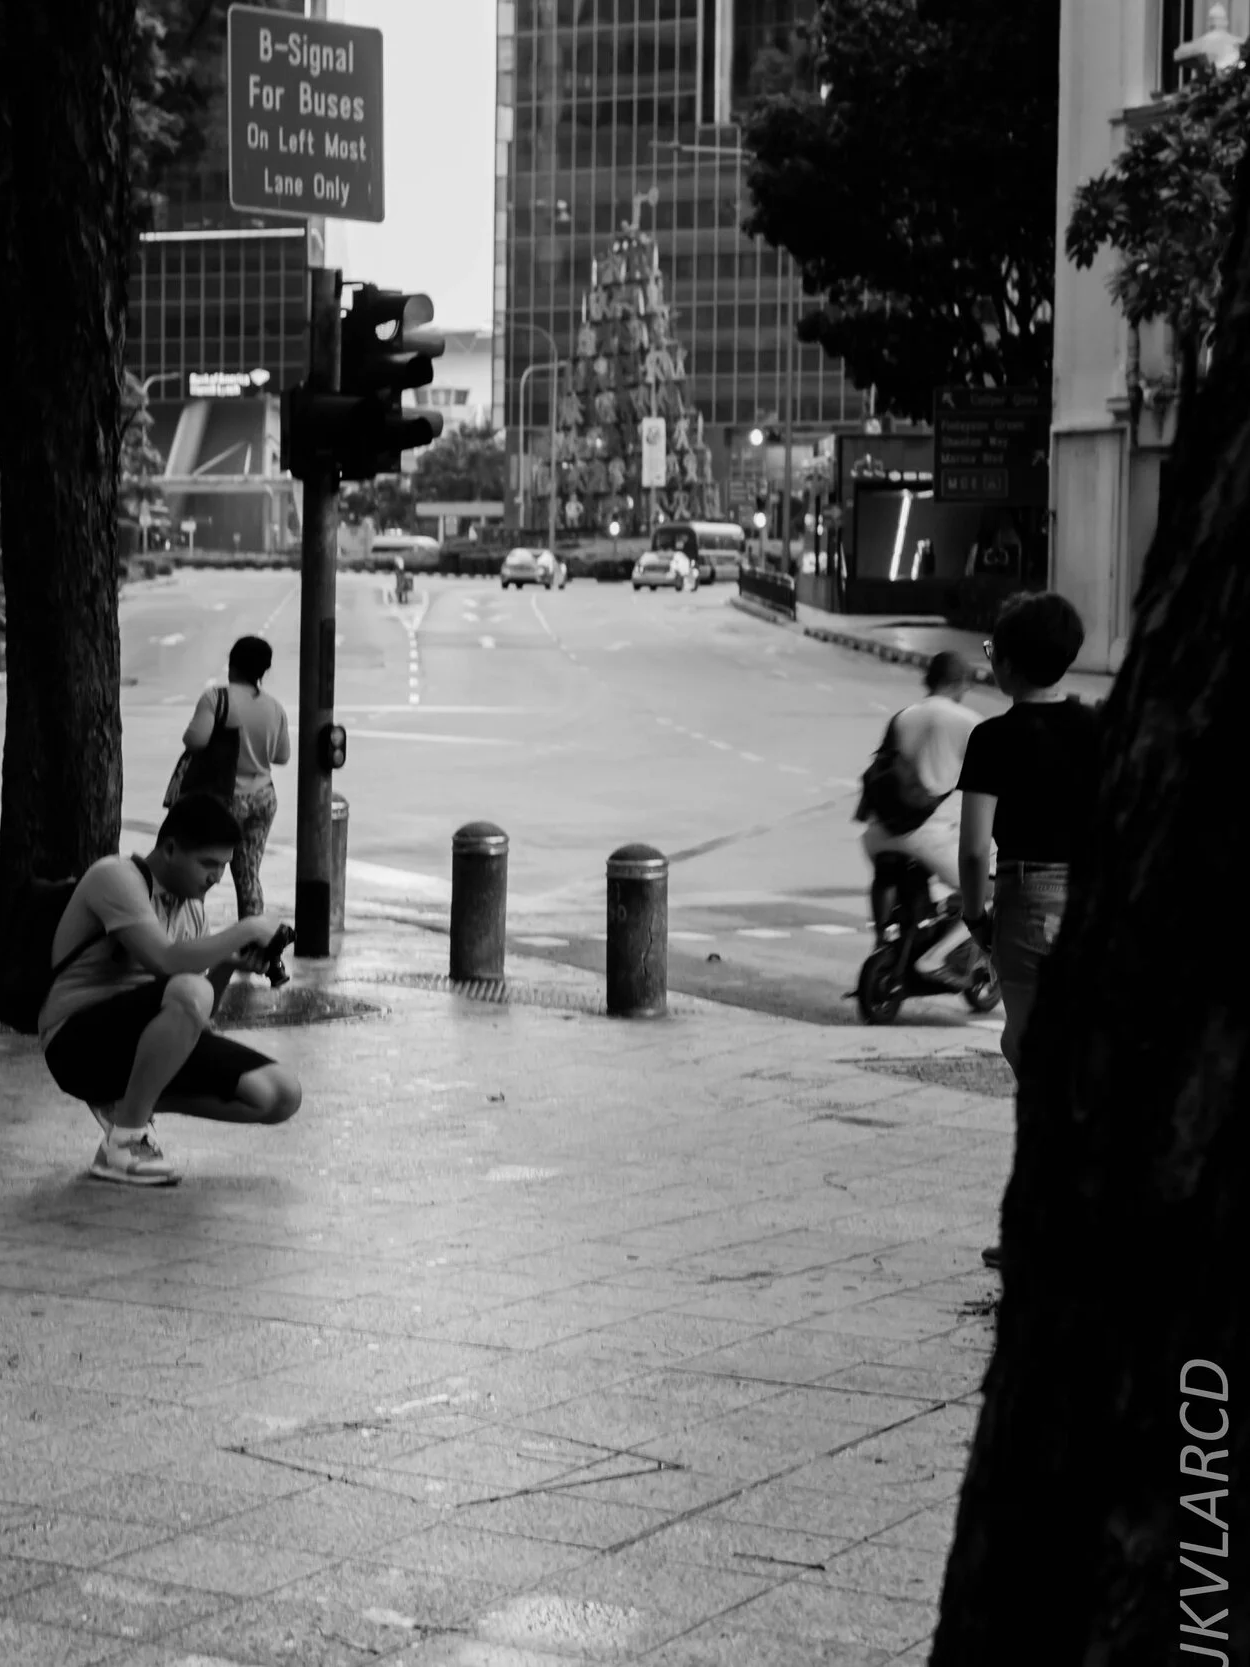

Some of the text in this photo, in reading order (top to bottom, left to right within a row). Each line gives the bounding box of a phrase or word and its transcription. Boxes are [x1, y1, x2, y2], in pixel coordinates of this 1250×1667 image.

[259, 27, 354, 78] B-Signal
[248, 74, 364, 122] For Buses
[247, 121, 367, 163] On Left Most
[264, 166, 350, 208] Lane Only
